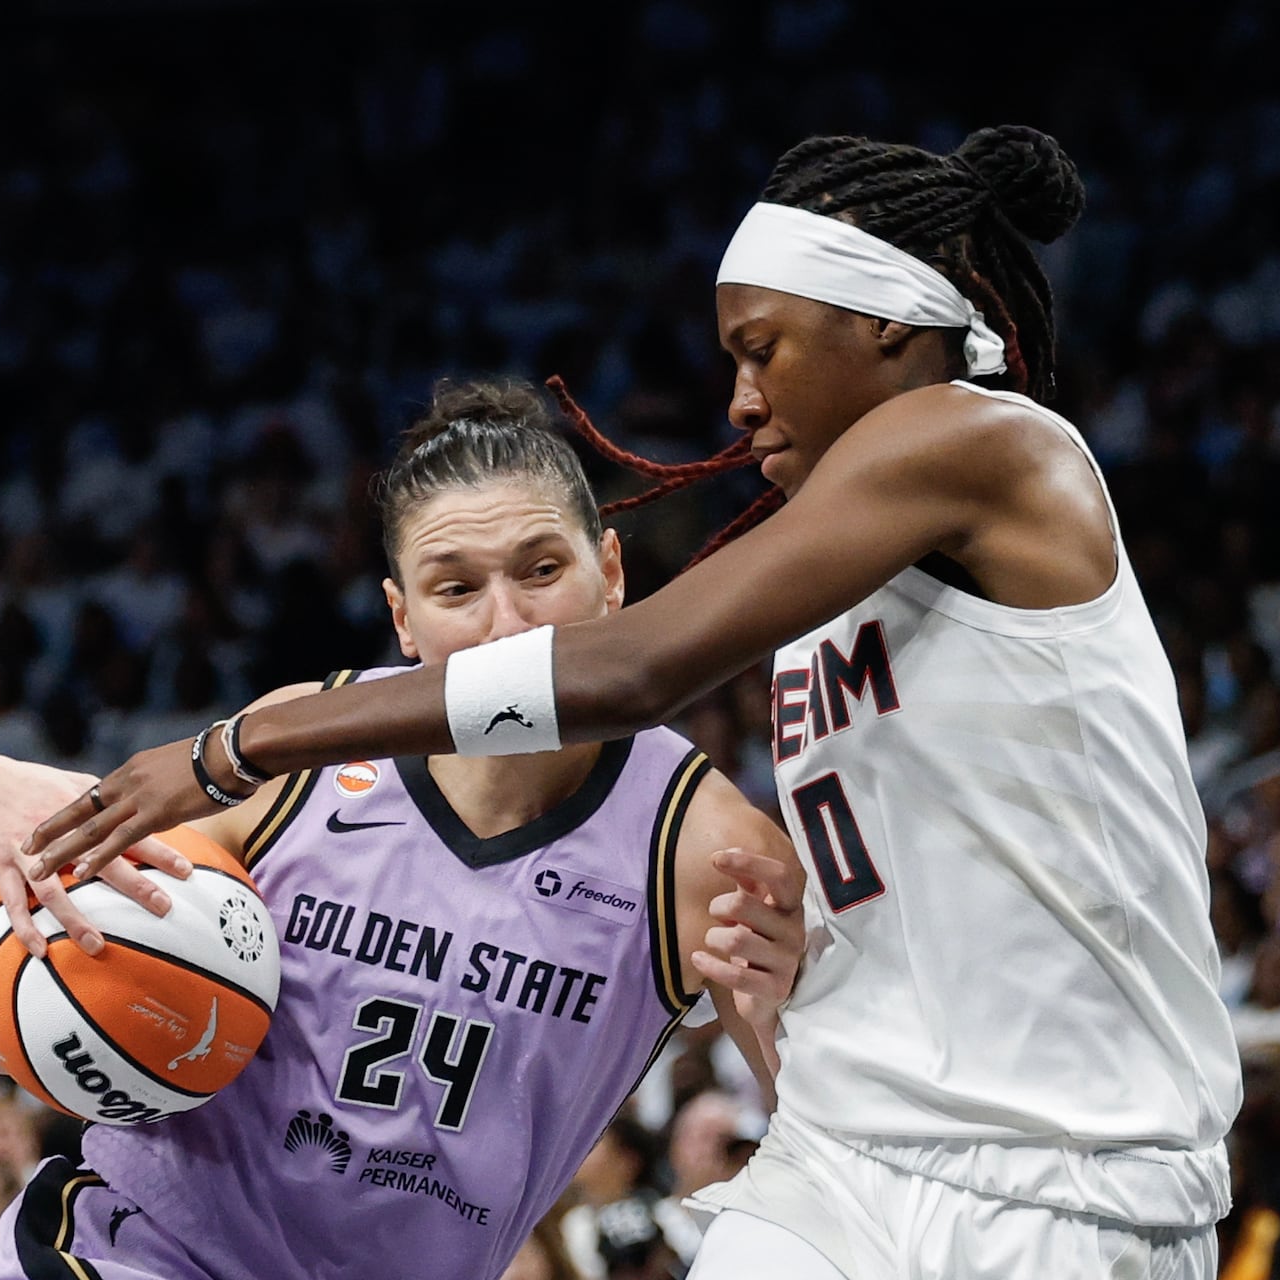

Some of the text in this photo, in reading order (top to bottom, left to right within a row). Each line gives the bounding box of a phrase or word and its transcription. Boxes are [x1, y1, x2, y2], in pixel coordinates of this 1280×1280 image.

[771, 620, 902, 767] EAM
[566, 881, 637, 912] freedom
[284, 893, 608, 1024] GOLDEN STATE
[335, 995, 496, 1133] 24
[358, 1168, 492, 1226] PERMANENTE
[366, 1148, 437, 1171] KAISER
